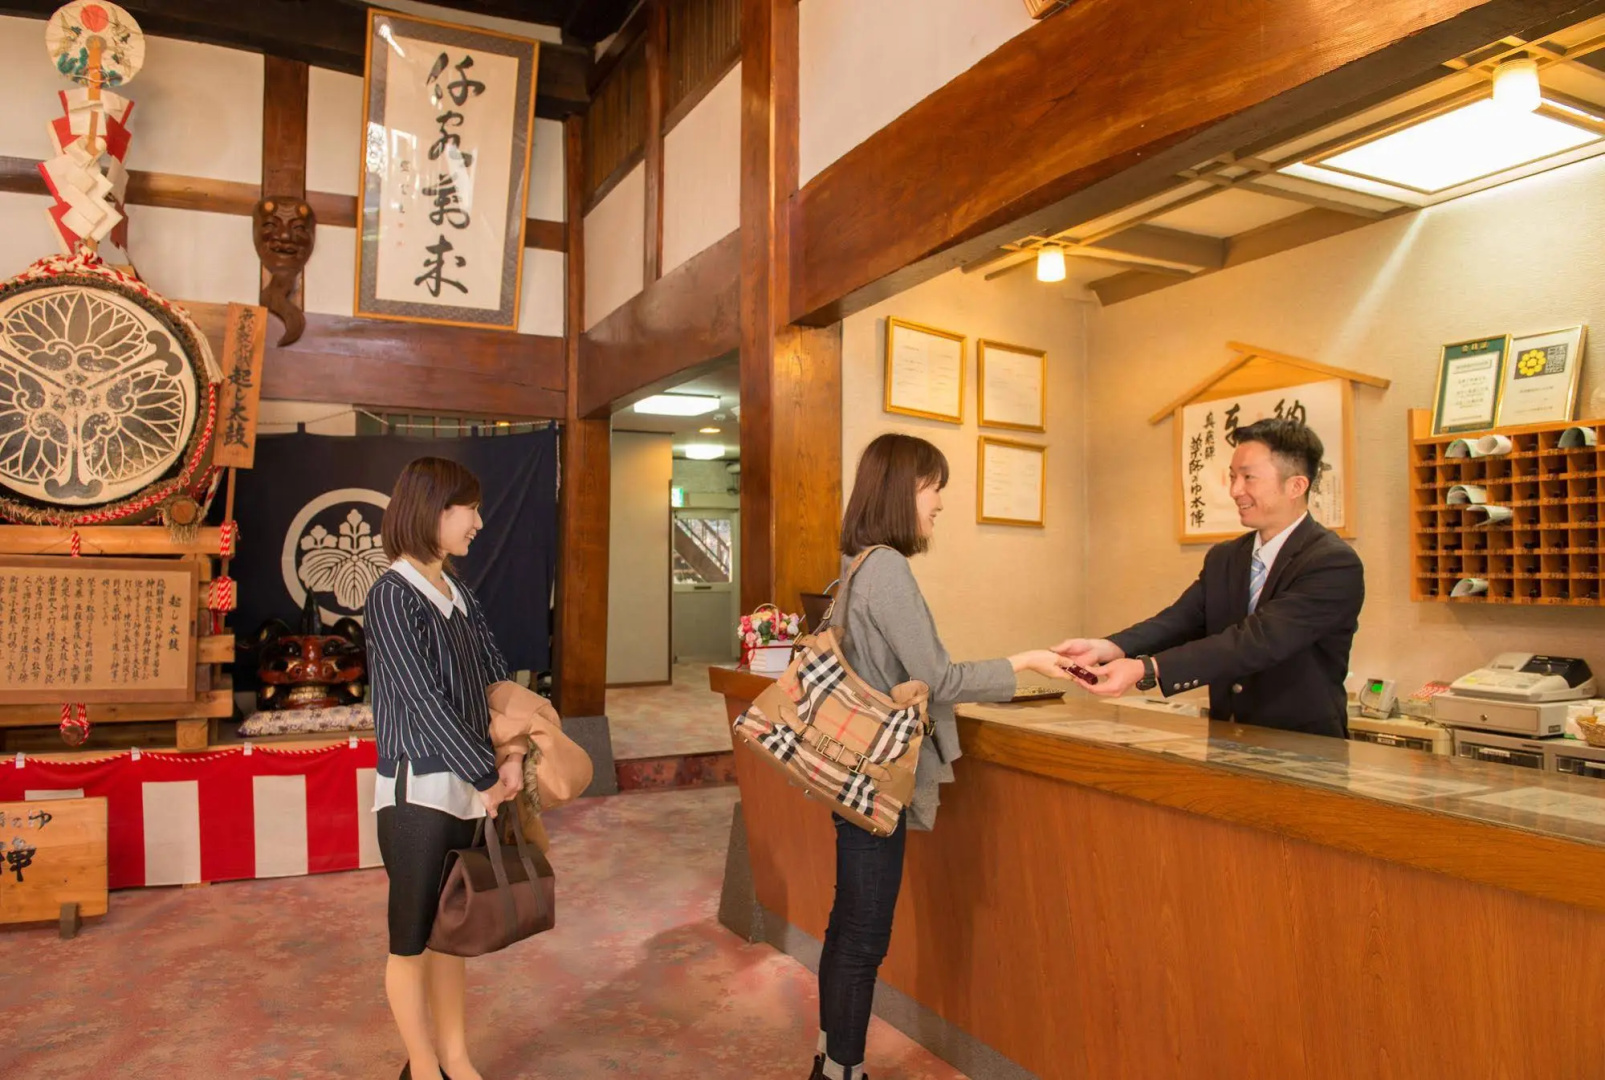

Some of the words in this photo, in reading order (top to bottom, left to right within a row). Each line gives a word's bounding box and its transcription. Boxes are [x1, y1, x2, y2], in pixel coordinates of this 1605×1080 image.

[1188, 432, 1206, 528] 薬師のゆ本陣
